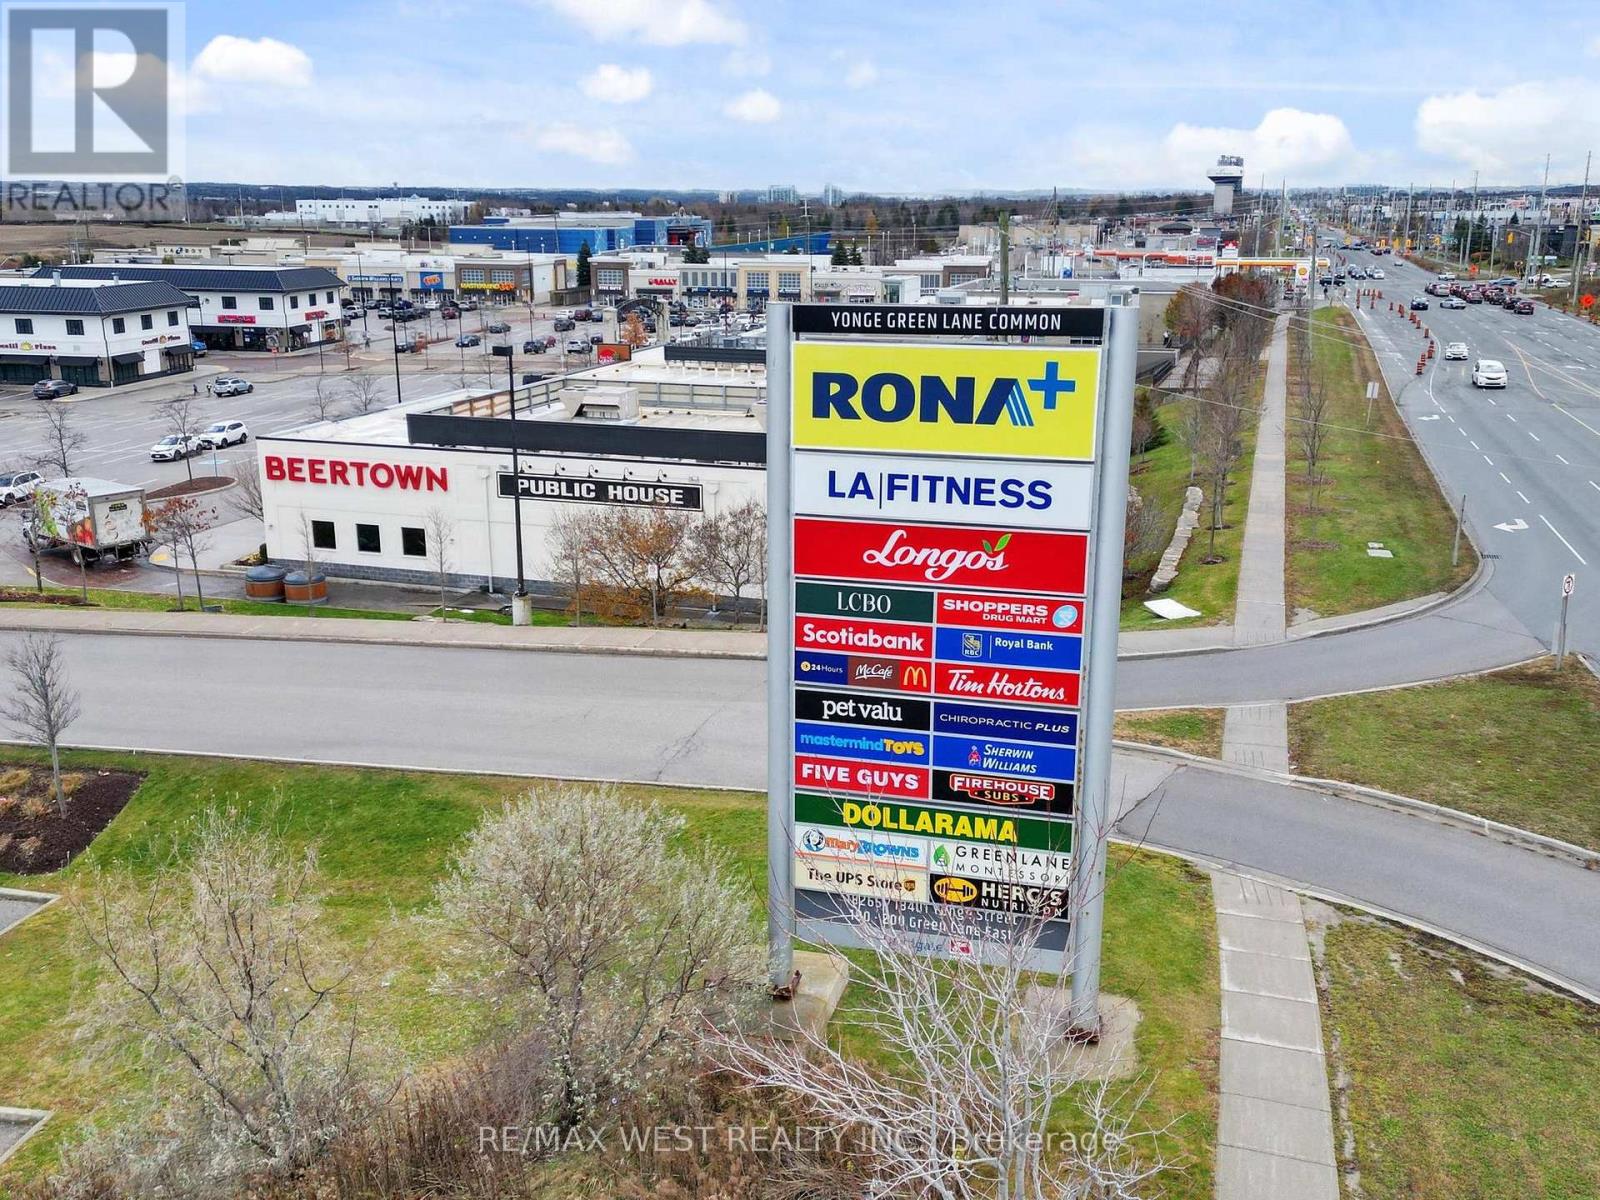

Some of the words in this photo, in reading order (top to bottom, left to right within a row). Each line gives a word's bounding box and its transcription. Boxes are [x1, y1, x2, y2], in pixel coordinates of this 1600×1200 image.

[831, 312, 882, 328] YONGE
[887, 312, 937, 329] GREEN
[943, 313, 983, 330] LANE
[989, 314, 1062, 331] COMMON
[265, 456, 449, 493] BEERTOWN
[517, 479, 595, 498] PUBLIC
[607, 485, 684, 504] HOUSE
[886, 472, 1053, 510] FITNESS
[837, 591, 892, 614] LCBO
[943, 599, 1049, 616] SHOPPERS
[982, 613, 1014, 622] DRUG
[1016, 616, 1048, 624] MART
[802, 623, 925, 651] Scotiabank
[994, 637, 1024, 649] Royal
[1026, 639, 1054, 651] Bank
[948, 669, 985, 695] Tim
[986, 671, 1066, 701] Hortons
[822, 699, 856, 719] pet
[857, 702, 903, 721] valu
[939, 713, 1033, 730] CHIROPRACTIC
[1034, 723, 1071, 733] PLUS
[983, 744, 1034, 760] SHERWIN
[802, 763, 851, 783] FIVE
[856, 769, 920, 790] GUYS
[982, 757, 1038, 774] WILLIAMS
[953, 776, 1052, 801] FIREHOUSE
[984, 790, 1019, 802] SUBS
[842, 801, 1018, 843] DOLLARAMA
[955, 845, 1070, 871] GREENLANE
[807, 868, 832, 882] The
[835, 871, 863, 886] UPS
[866, 875, 902, 891] Store
[955, 863, 1070, 886] MONTESSORI
[981, 897, 1063, 917] NUTRION
